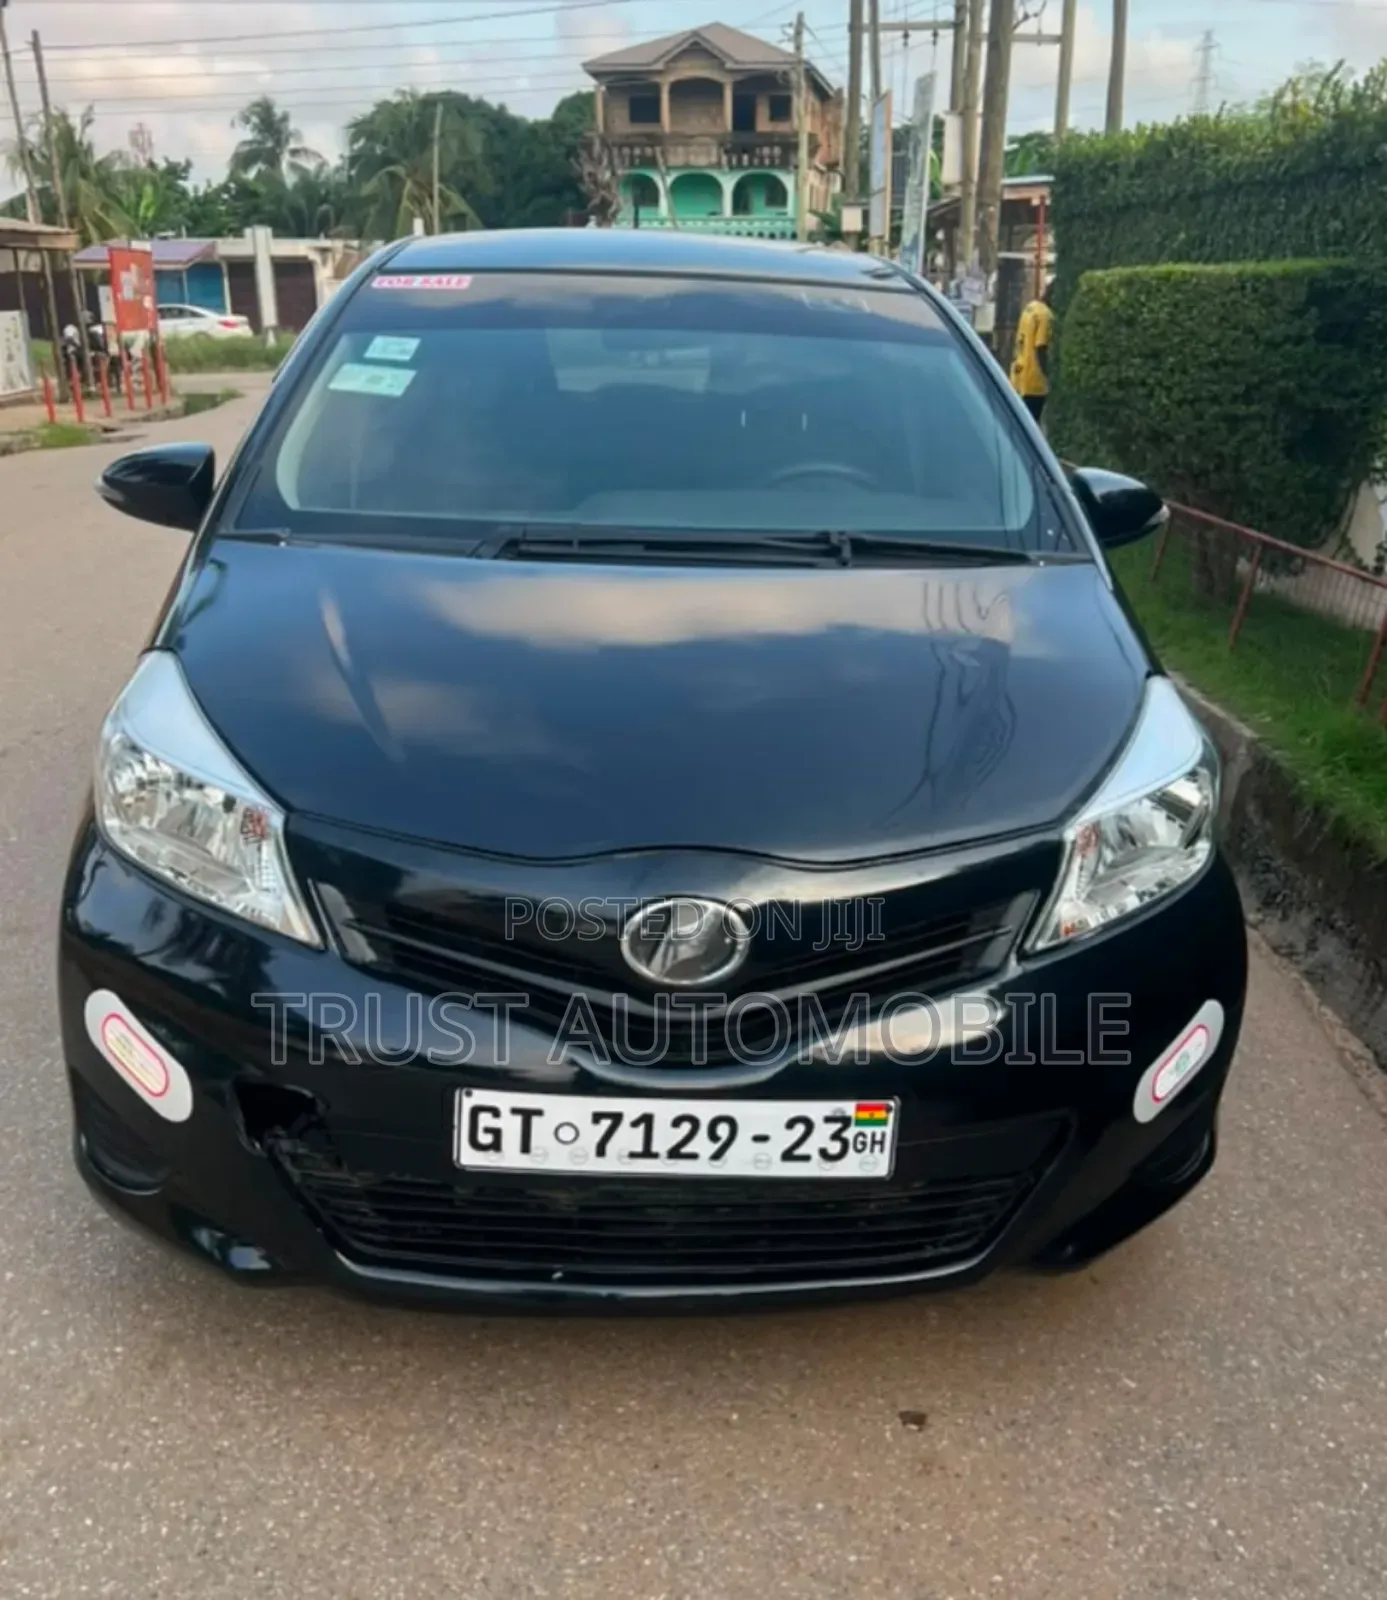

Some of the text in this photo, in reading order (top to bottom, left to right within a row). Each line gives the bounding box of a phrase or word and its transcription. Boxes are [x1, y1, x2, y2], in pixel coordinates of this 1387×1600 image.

[422, 276, 468, 288] SALE
[467, 1104, 544, 1154] GT
[852, 1131, 886, 1154] GH
